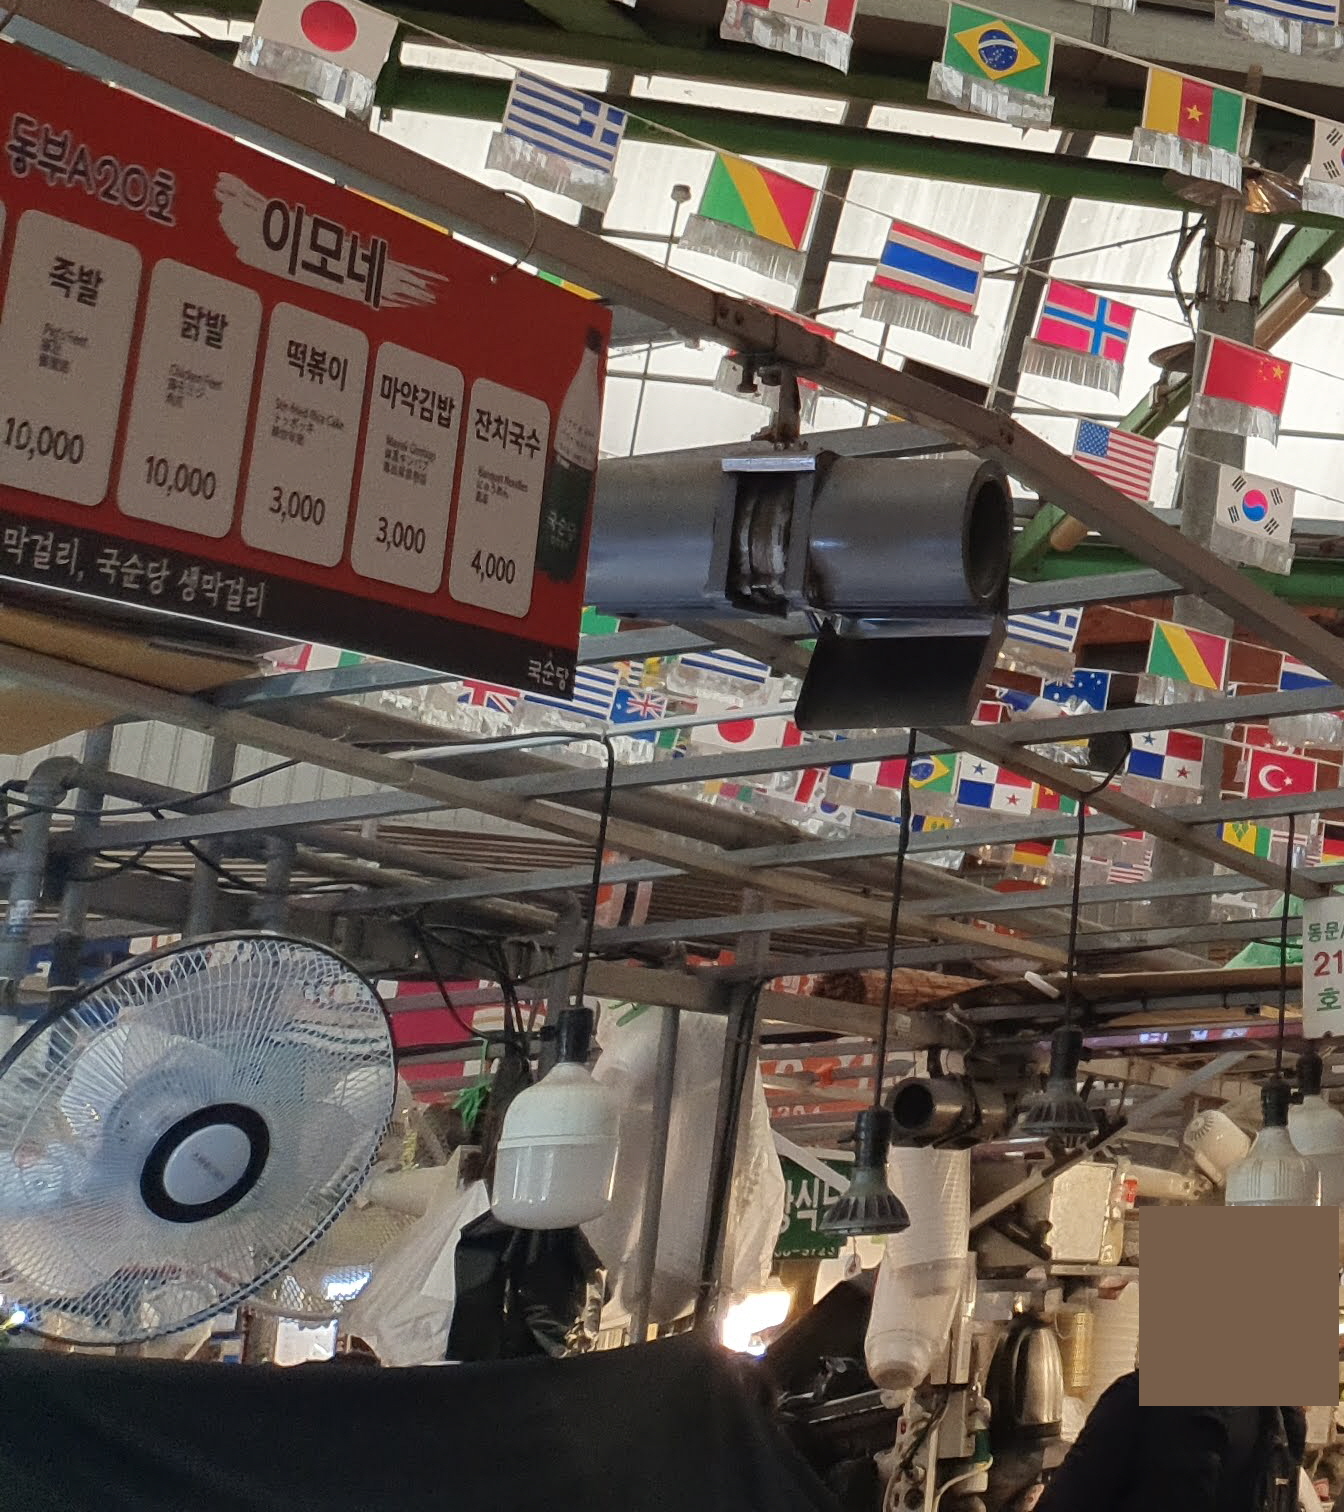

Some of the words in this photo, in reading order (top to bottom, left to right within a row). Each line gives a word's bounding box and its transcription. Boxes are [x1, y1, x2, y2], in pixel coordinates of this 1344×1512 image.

[6, 111, 176, 227] 동부A20호
[262, 198, 388, 309] 이모네
[49, 256, 103, 308] 족발
[180, 302, 229, 350] 닭발
[287, 340, 349, 392] 떡볶이
[380, 374, 455, 429] 마약김밥
[3, 417, 84, 465] 10,000
[474, 408, 541, 459] 잔치국수
[145, 454, 216, 502] 10,000
[269, 485, 326, 525] 3,000
[376, 516, 426, 554] 3,000
[96, 549, 170, 596] 국순당
[178, 565, 266, 618] 생막걸리
[471, 550, 516, 584] 4,000
[527, 659, 570, 691] 국순당
[1313, 949, 1344, 978] 21
[1316, 986, 1343, 1012] 호
